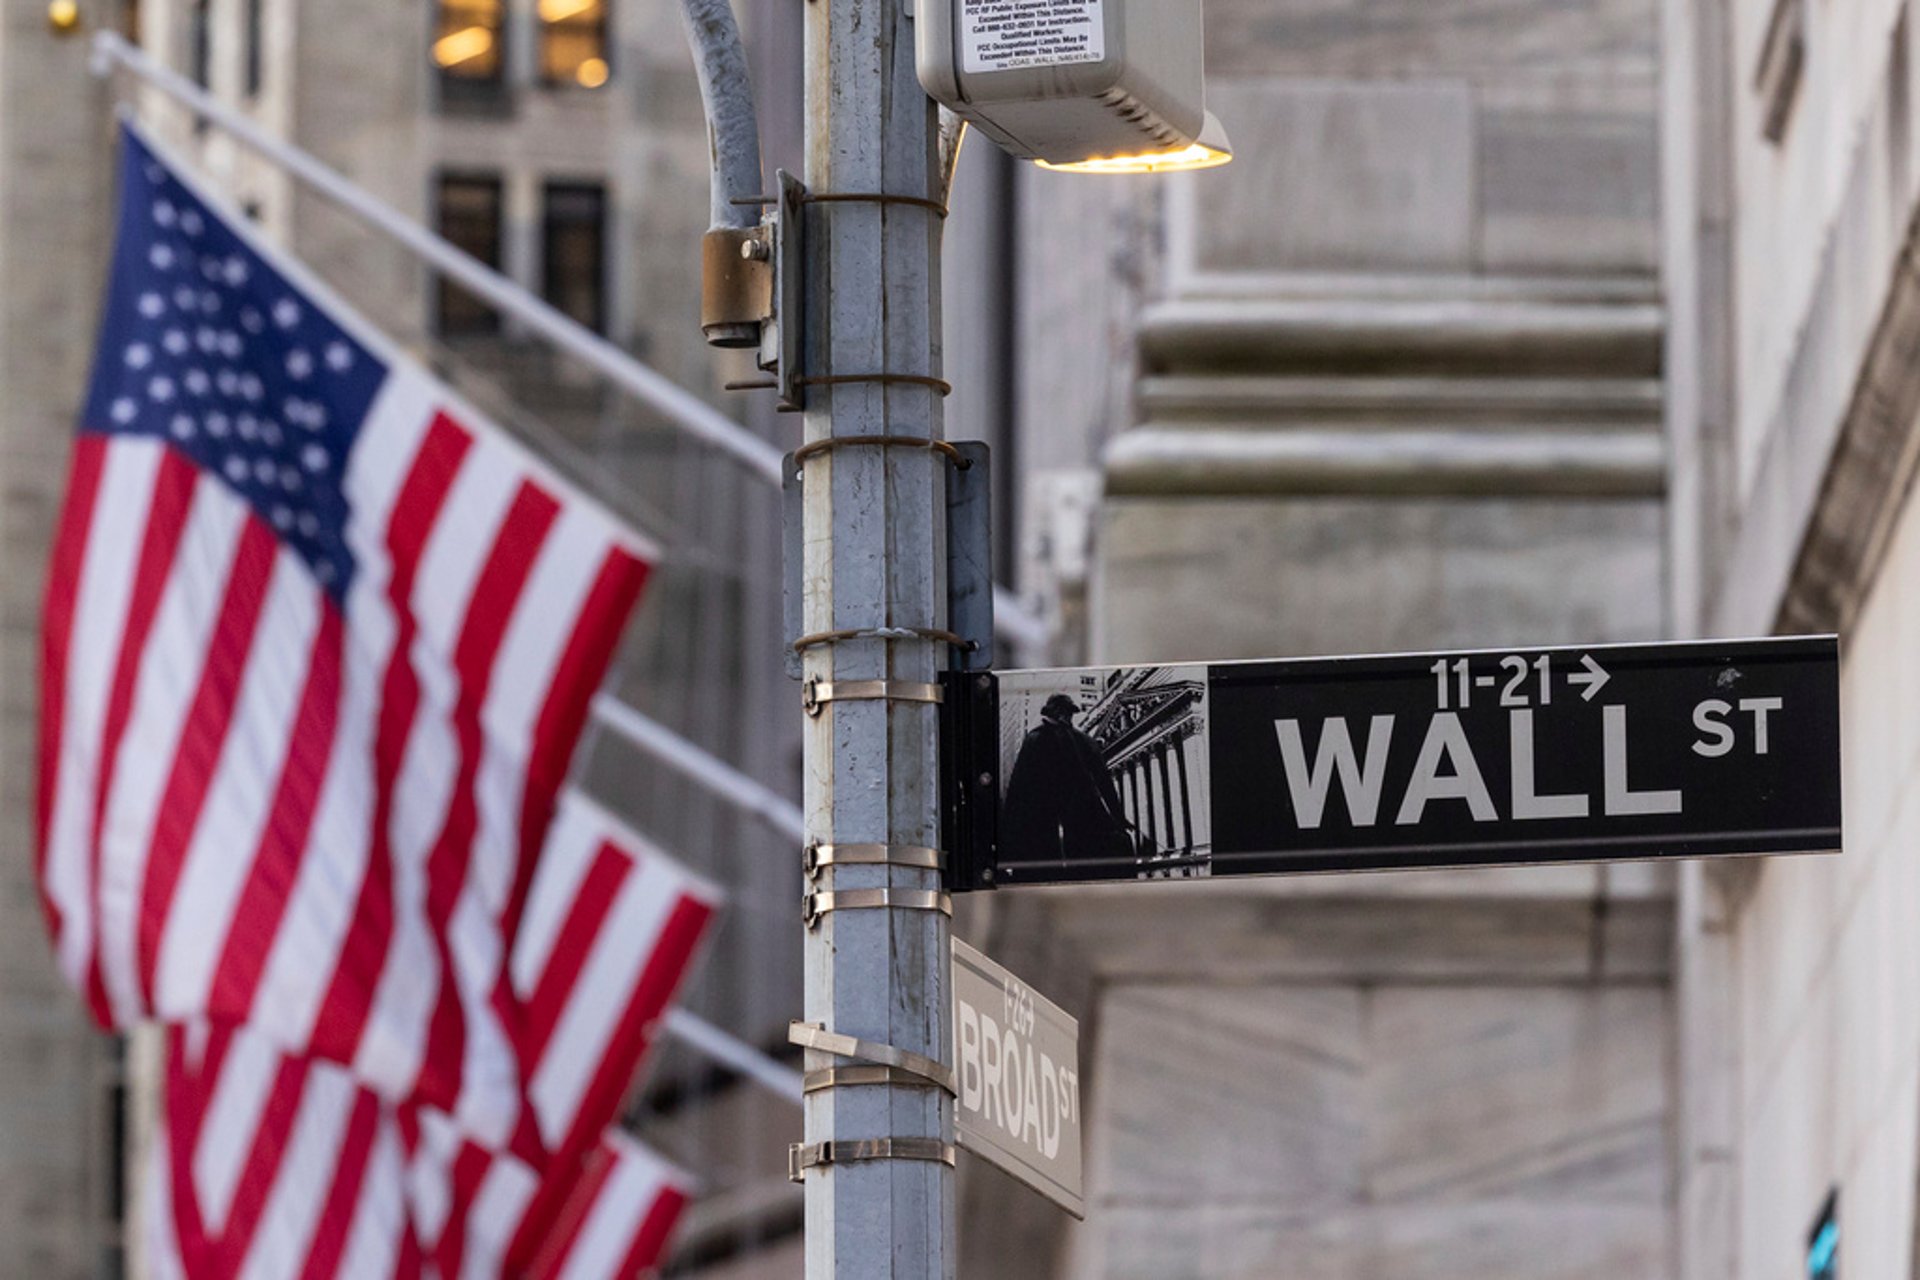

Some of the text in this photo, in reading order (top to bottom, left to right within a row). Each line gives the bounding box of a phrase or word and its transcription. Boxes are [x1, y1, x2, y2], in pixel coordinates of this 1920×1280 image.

[978, 13, 1011, 23] Exceeded
[1037, 9, 1051, 17] This
[1053, 7, 1084, 16] Distance.
[991, 4, 1012, 12] Public
[1015, 2, 1046, 10] Exposure
[973, 25, 985, 33] Call
[1036, 19, 1047, 27] for
[1001, 29, 1031, 39] Qualified
[992, 38, 1037, 50] Occupational
[1038, 37, 1060, 46] Limits
[1062, 35, 1077, 43] May
[1079, 34, 1088, 42] Be
[980, 51, 1013, 61] Exceeded
[1038, 46, 1052, 55] This
[1054, 44, 1085, 53] Distance.
[1431, 654, 1551, 709] 11-21
[1274, 697, 1783, 829] WALL ST
[959, 1000, 1078, 1160] BROAD ST
